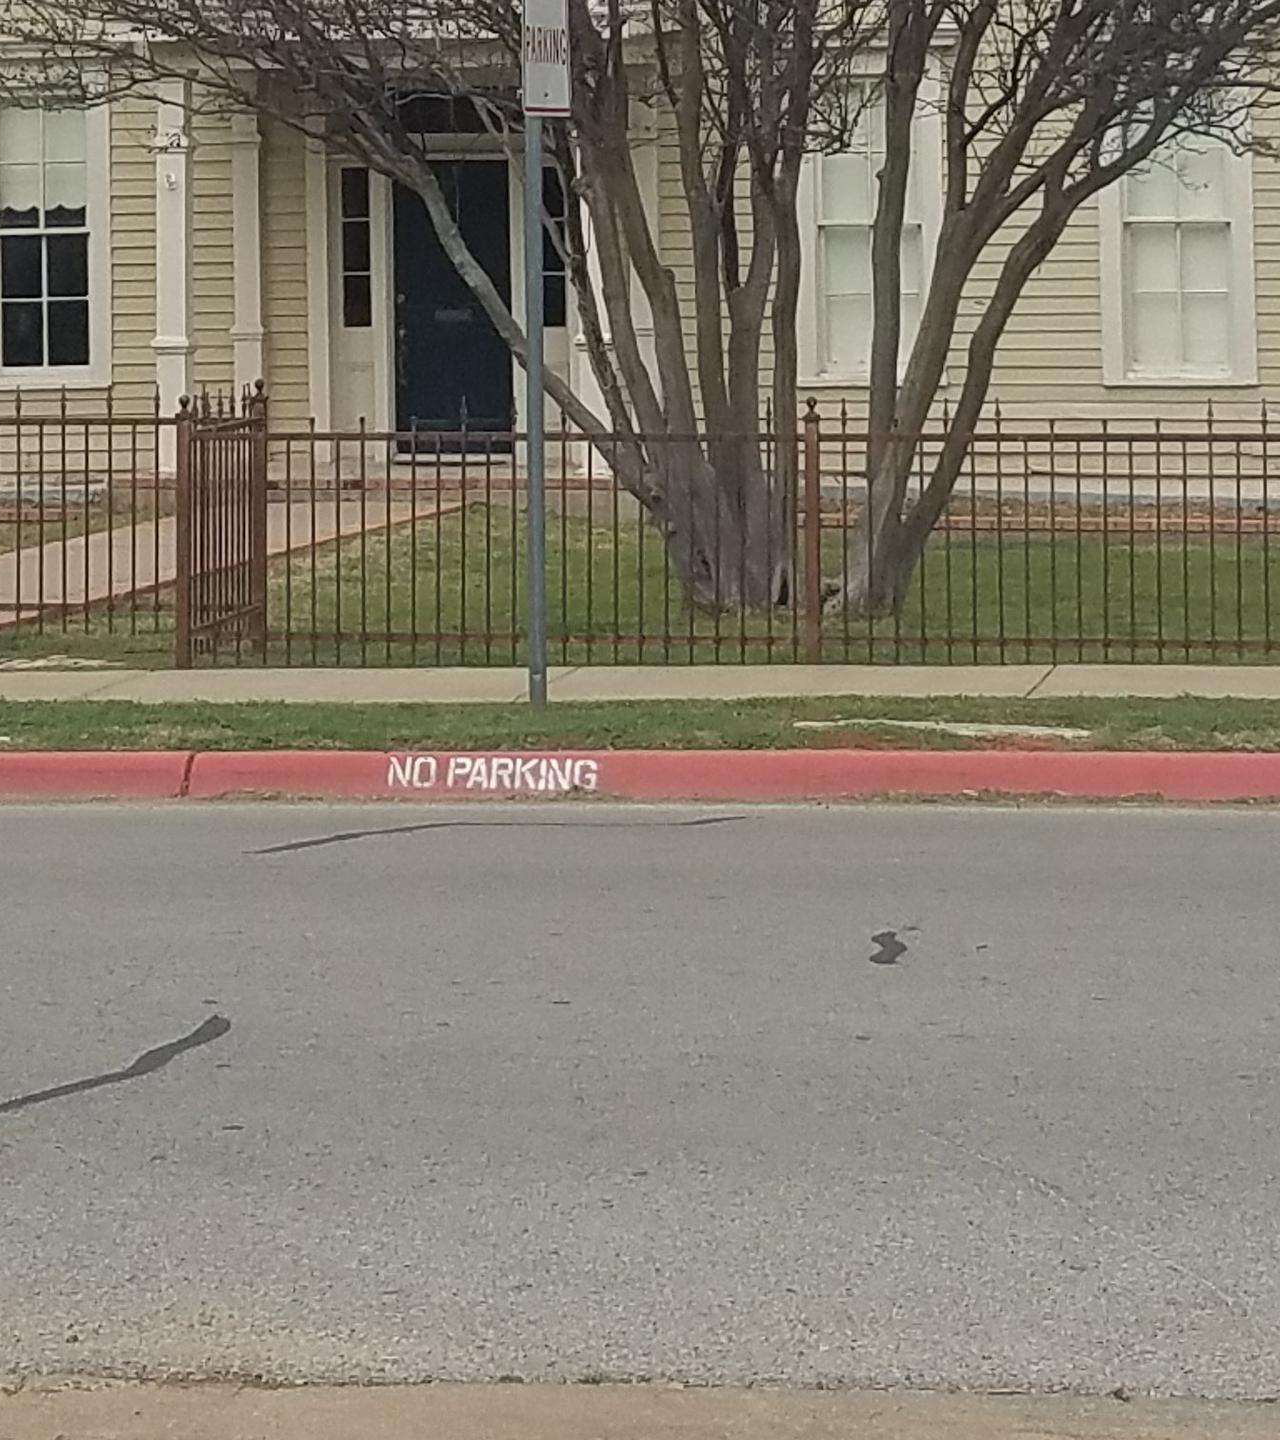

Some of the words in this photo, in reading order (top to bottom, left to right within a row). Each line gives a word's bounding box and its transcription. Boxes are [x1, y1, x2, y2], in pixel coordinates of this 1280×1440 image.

[526, 24, 568, 66] PARKING
[388, 756, 438, 788] NO
[446, 756, 599, 791] PARKING
